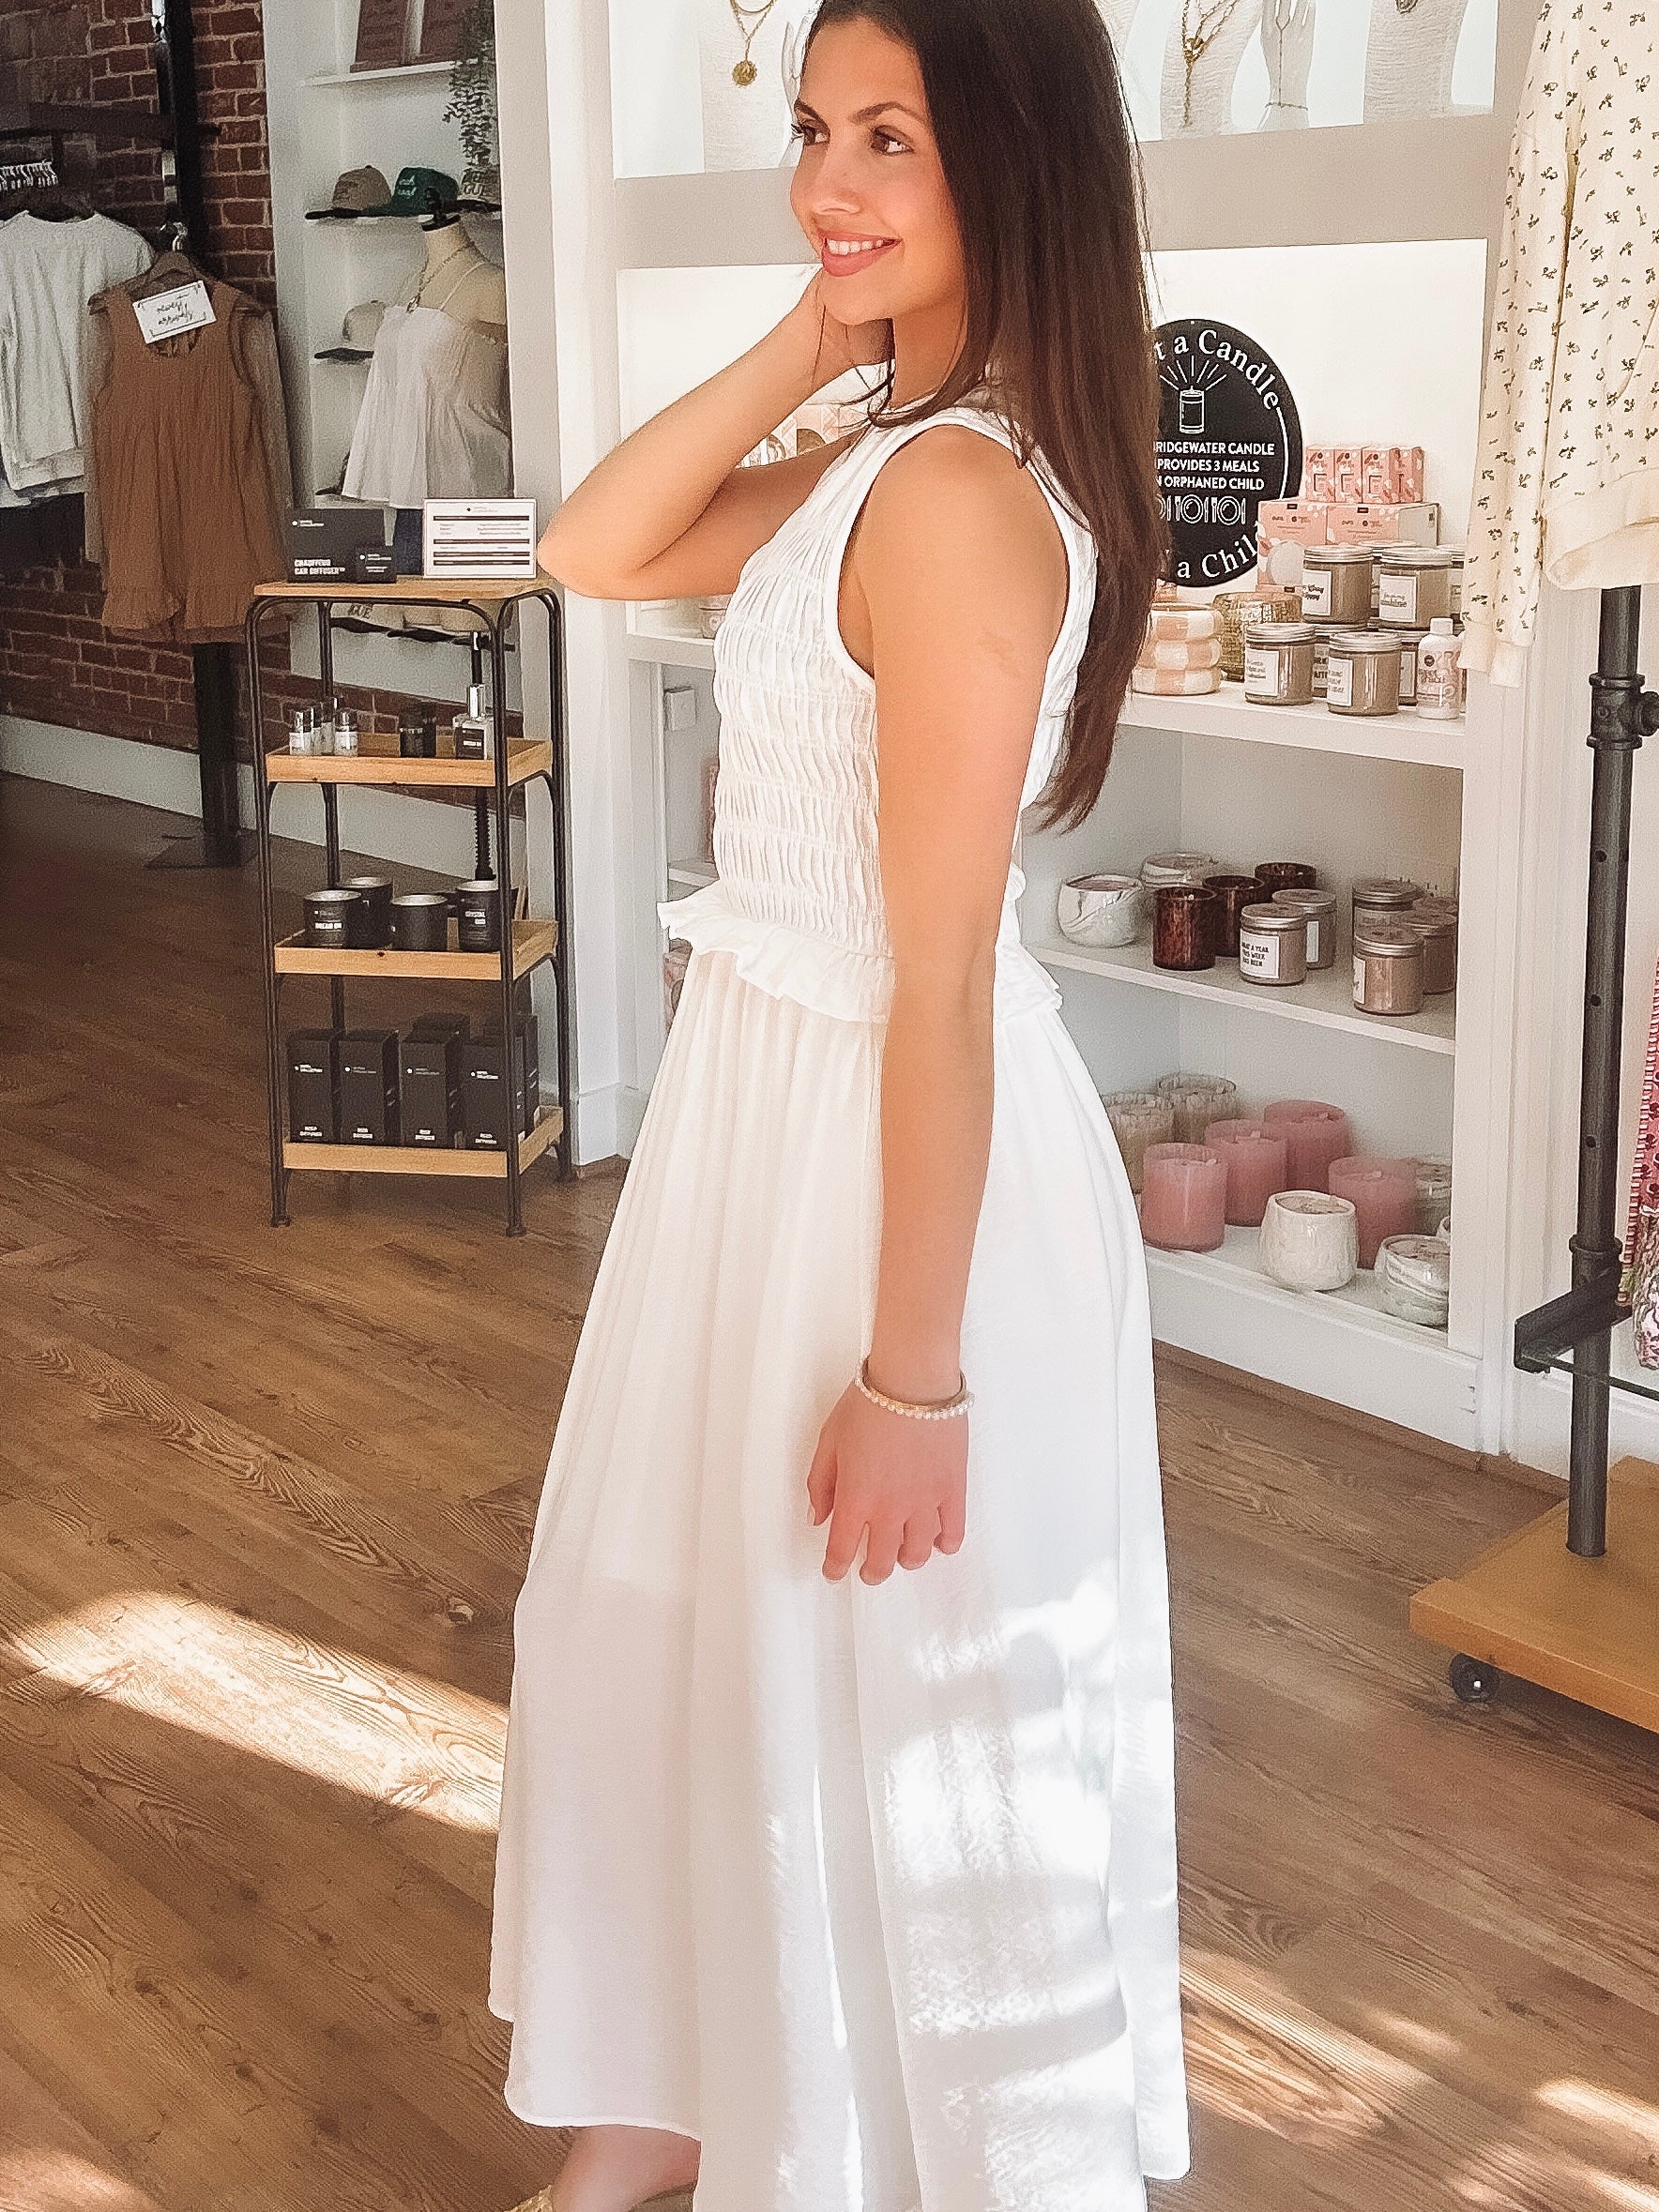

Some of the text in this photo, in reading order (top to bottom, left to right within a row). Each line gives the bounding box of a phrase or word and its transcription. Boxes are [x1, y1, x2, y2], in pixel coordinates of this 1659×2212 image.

[1173, 335, 1190, 355] a
[1198, 329, 1279, 410] Candle
[1153, 441, 1275, 456] RIDGEWATER CANDLE
[1157, 458, 1260, 473] PROVIDES 3 MEALS
[1164, 475, 1227, 489] ORPHANED
[1228, 477, 1265, 491] CHILD
[1177, 531, 1258, 579] a Chil
